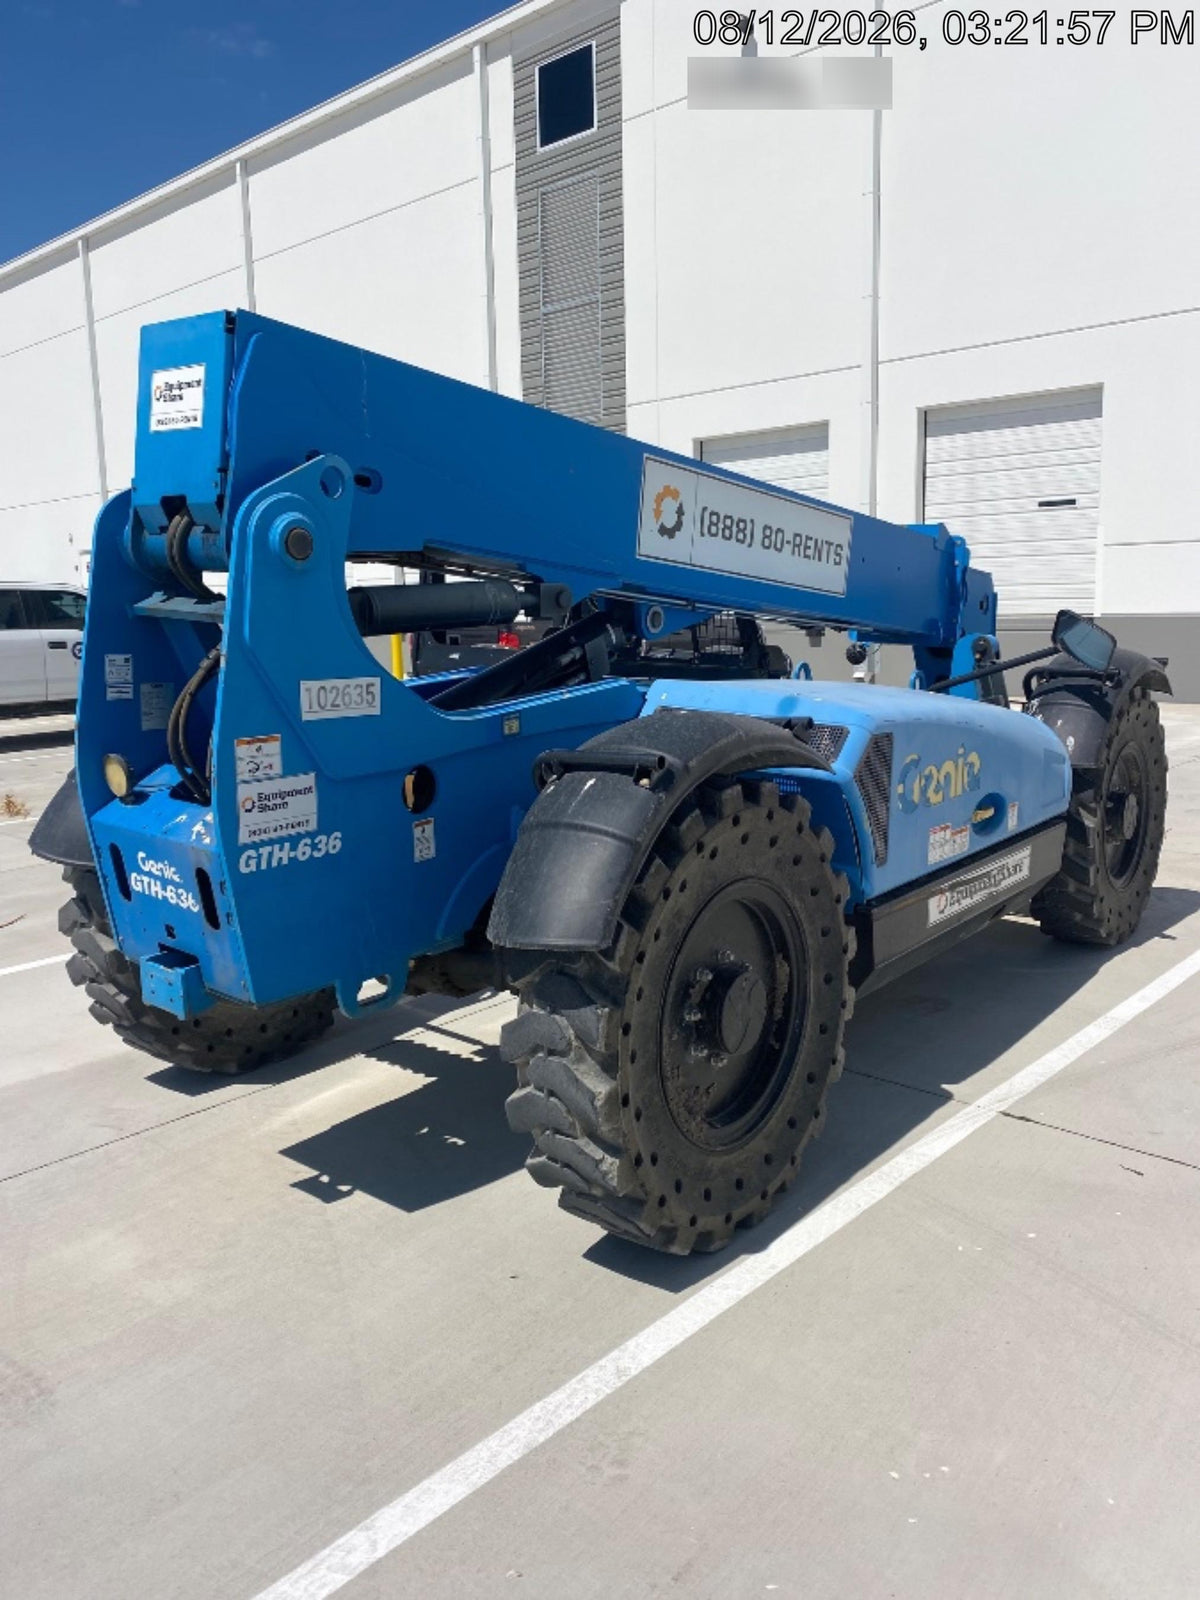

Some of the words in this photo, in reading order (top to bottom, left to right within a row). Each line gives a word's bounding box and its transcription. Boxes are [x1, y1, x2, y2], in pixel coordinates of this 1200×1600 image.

[700, 506, 755, 548] (888)
[761, 524, 844, 566] 80-RENTS
[304, 682, 376, 710] 102635
[239, 831, 342, 873] GTH-636
[131, 872, 199, 912] GTH-636
